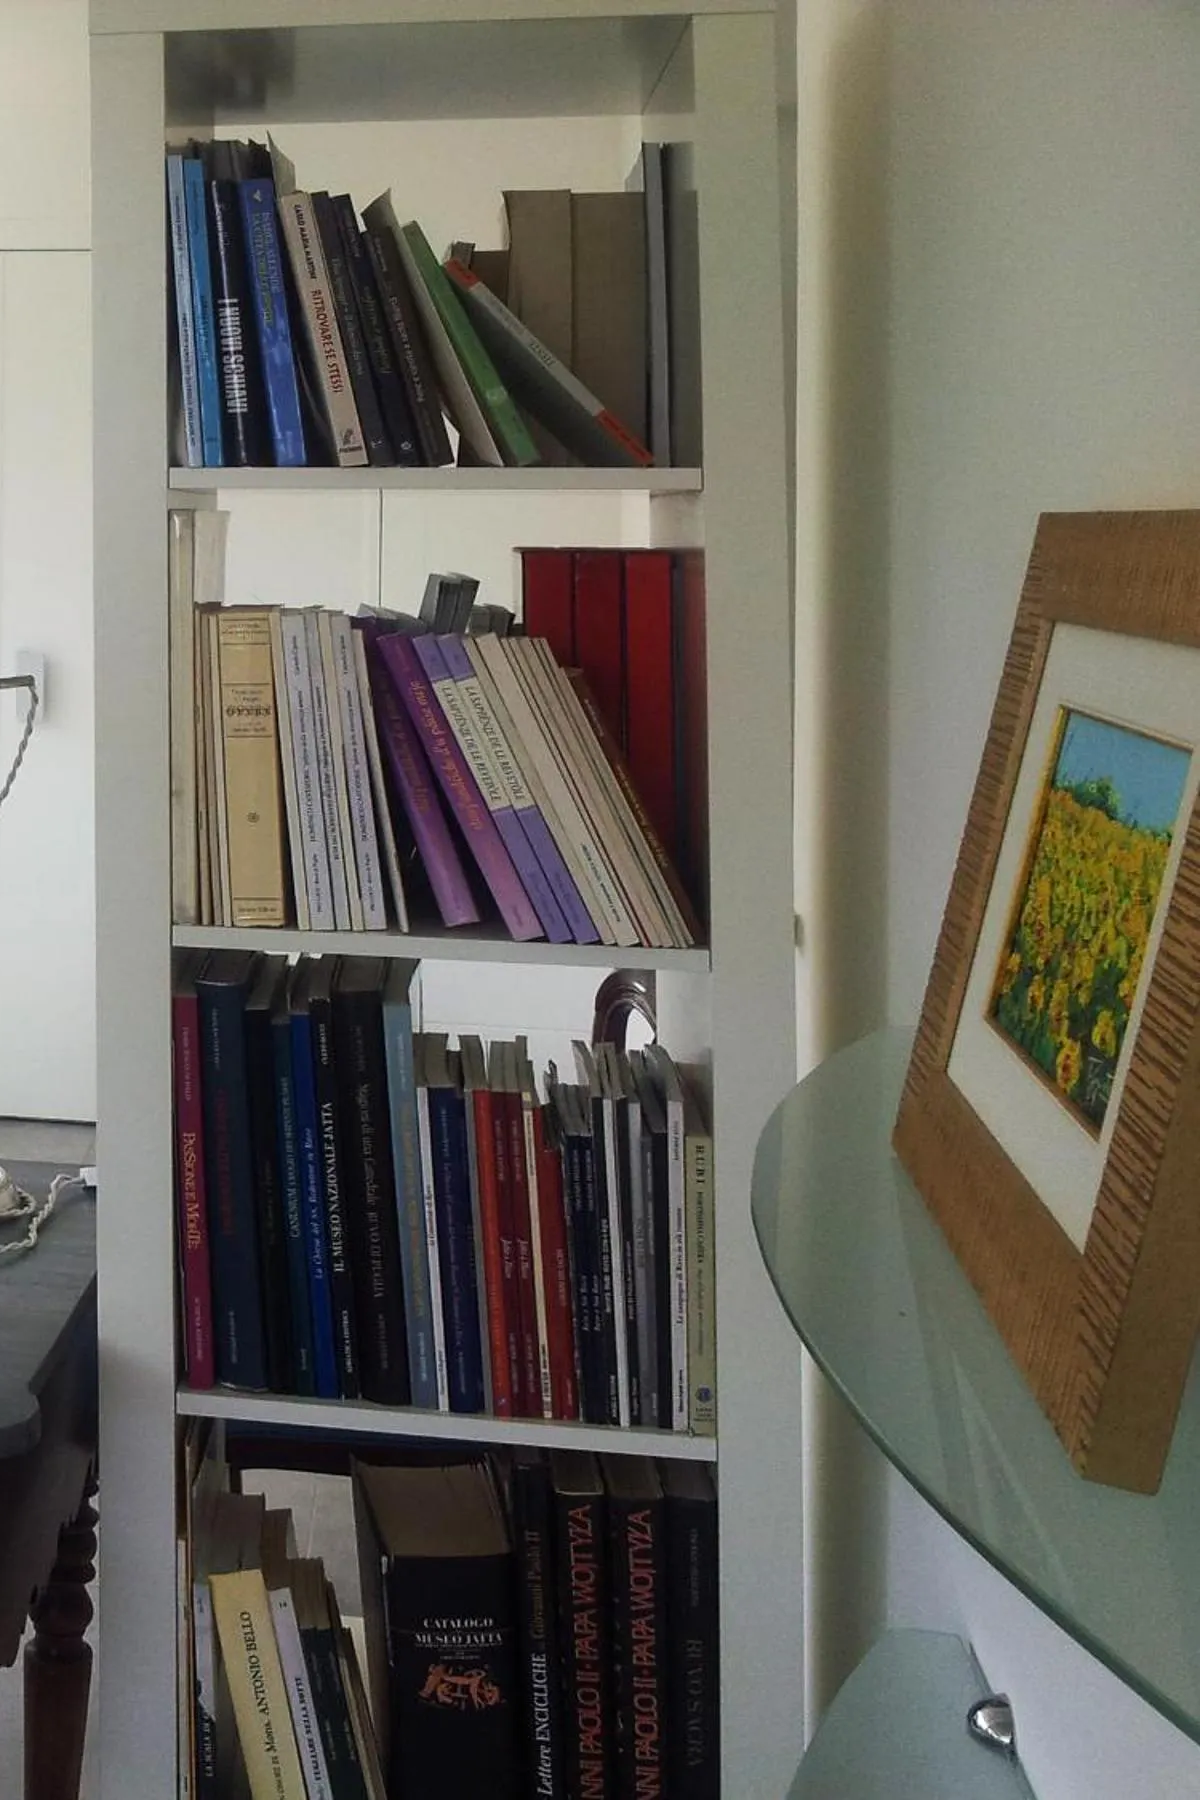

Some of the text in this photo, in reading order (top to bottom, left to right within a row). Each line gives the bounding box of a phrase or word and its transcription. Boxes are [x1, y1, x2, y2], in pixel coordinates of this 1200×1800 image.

[293, 205, 317, 280] CARLO MARIA MARTINI
[218, 306, 243, 351] NUOVI
[311, 290, 343, 393] RITROVARE SE STESSI
[221, 354, 248, 414] SCHIAVI
[441, 686, 454, 698] LA
[464, 686, 478, 698] LA
[182, 1132, 198, 1190] PASSIONE
[321, 1101, 345, 1272] IL MUSEO NAZIONALE JATTA
[186, 1201, 202, 1249] MORTE
[371, 1258, 385, 1297] PUGLIA
[239, 1611, 256, 1651] BELLO
[415, 1632, 502, 1644] MUSEO JATTA
[423, 1617, 493, 1628] CATALOGO
[574, 1609, 596, 1660] PAPA
[631, 1615, 657, 1666] PAPA
[247, 1656, 267, 1714] ANTONIO
[530, 1653, 552, 1740] ENCICLICHE
[685, 1639, 704, 1766] RUVO SACRA
[262, 1721, 277, 1752] Mons.
[302, 1705, 313, 1735] NELLA
[576, 1686, 602, 1754] PAOLO
[633, 1693, 661, 1760] PAOLO
[535, 1743, 554, 1796] Lettere
